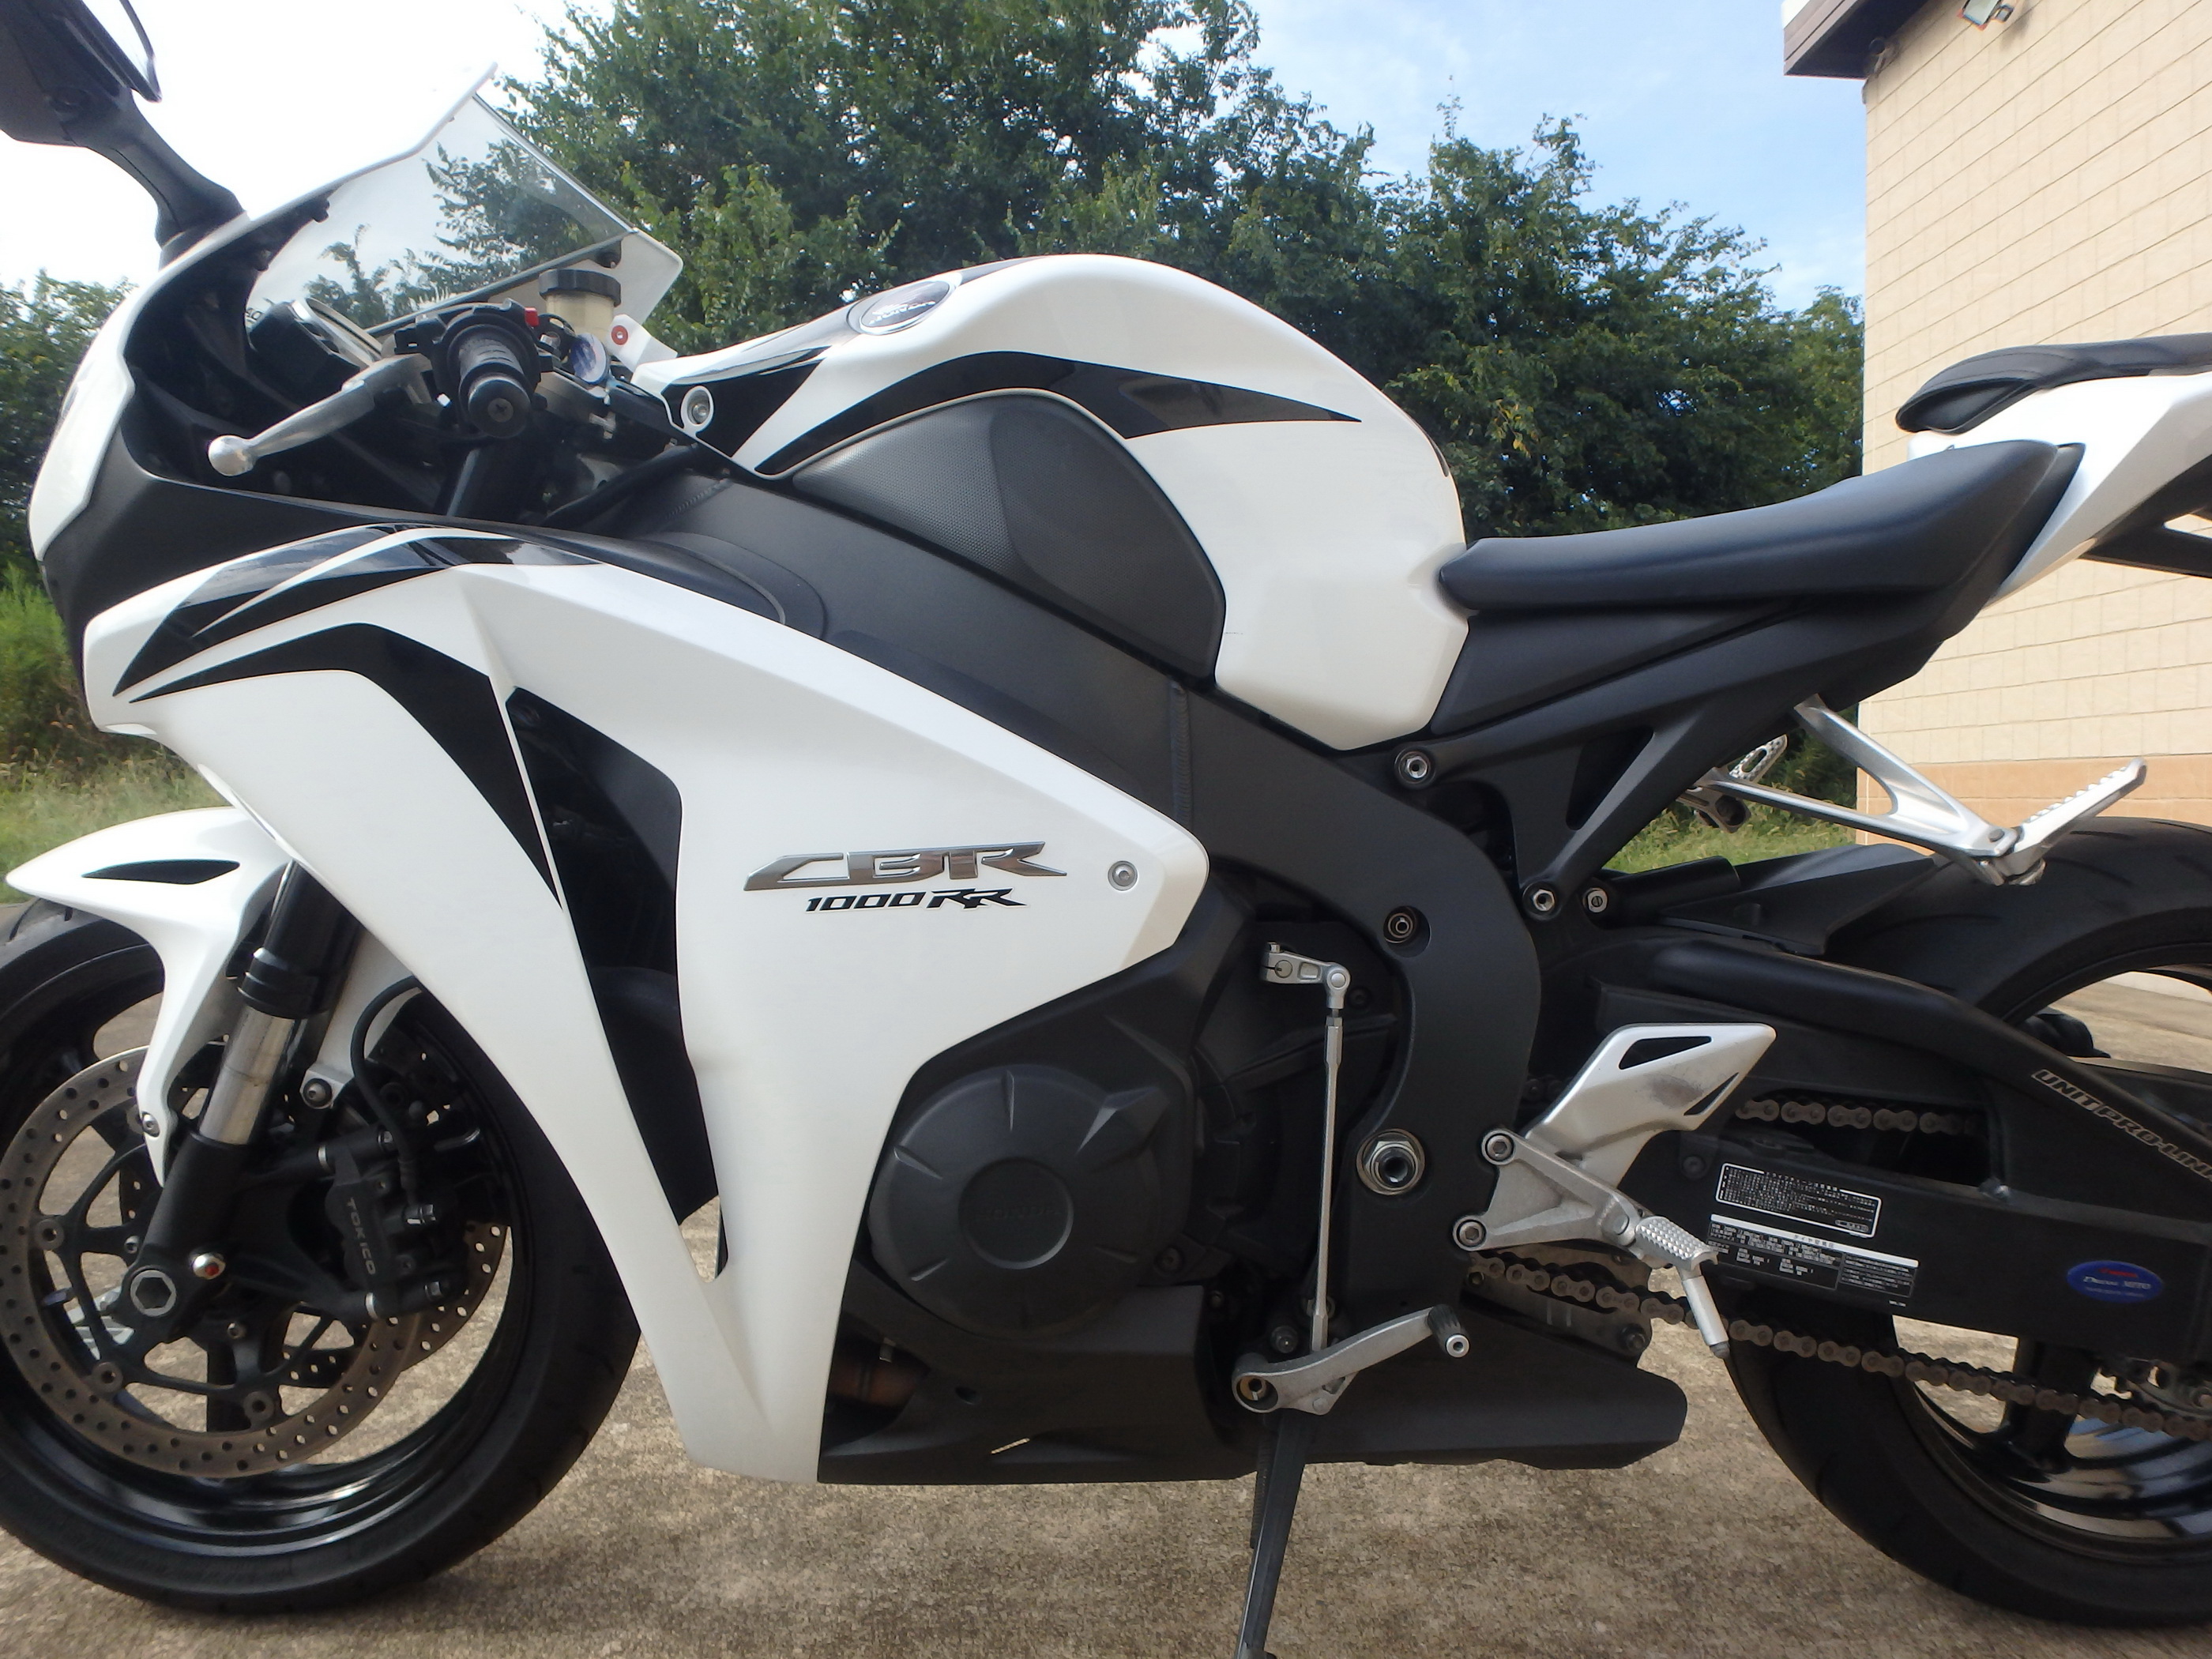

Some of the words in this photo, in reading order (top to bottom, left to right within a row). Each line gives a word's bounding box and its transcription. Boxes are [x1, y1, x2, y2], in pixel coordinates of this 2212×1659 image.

[743, 841, 1068, 891] CBR
[2032, 1070, 2102, 1111] UNIT
[2096, 1106, 2212, 1182] PRO-LIN
[347, 1198, 376, 1275] TOKICO
